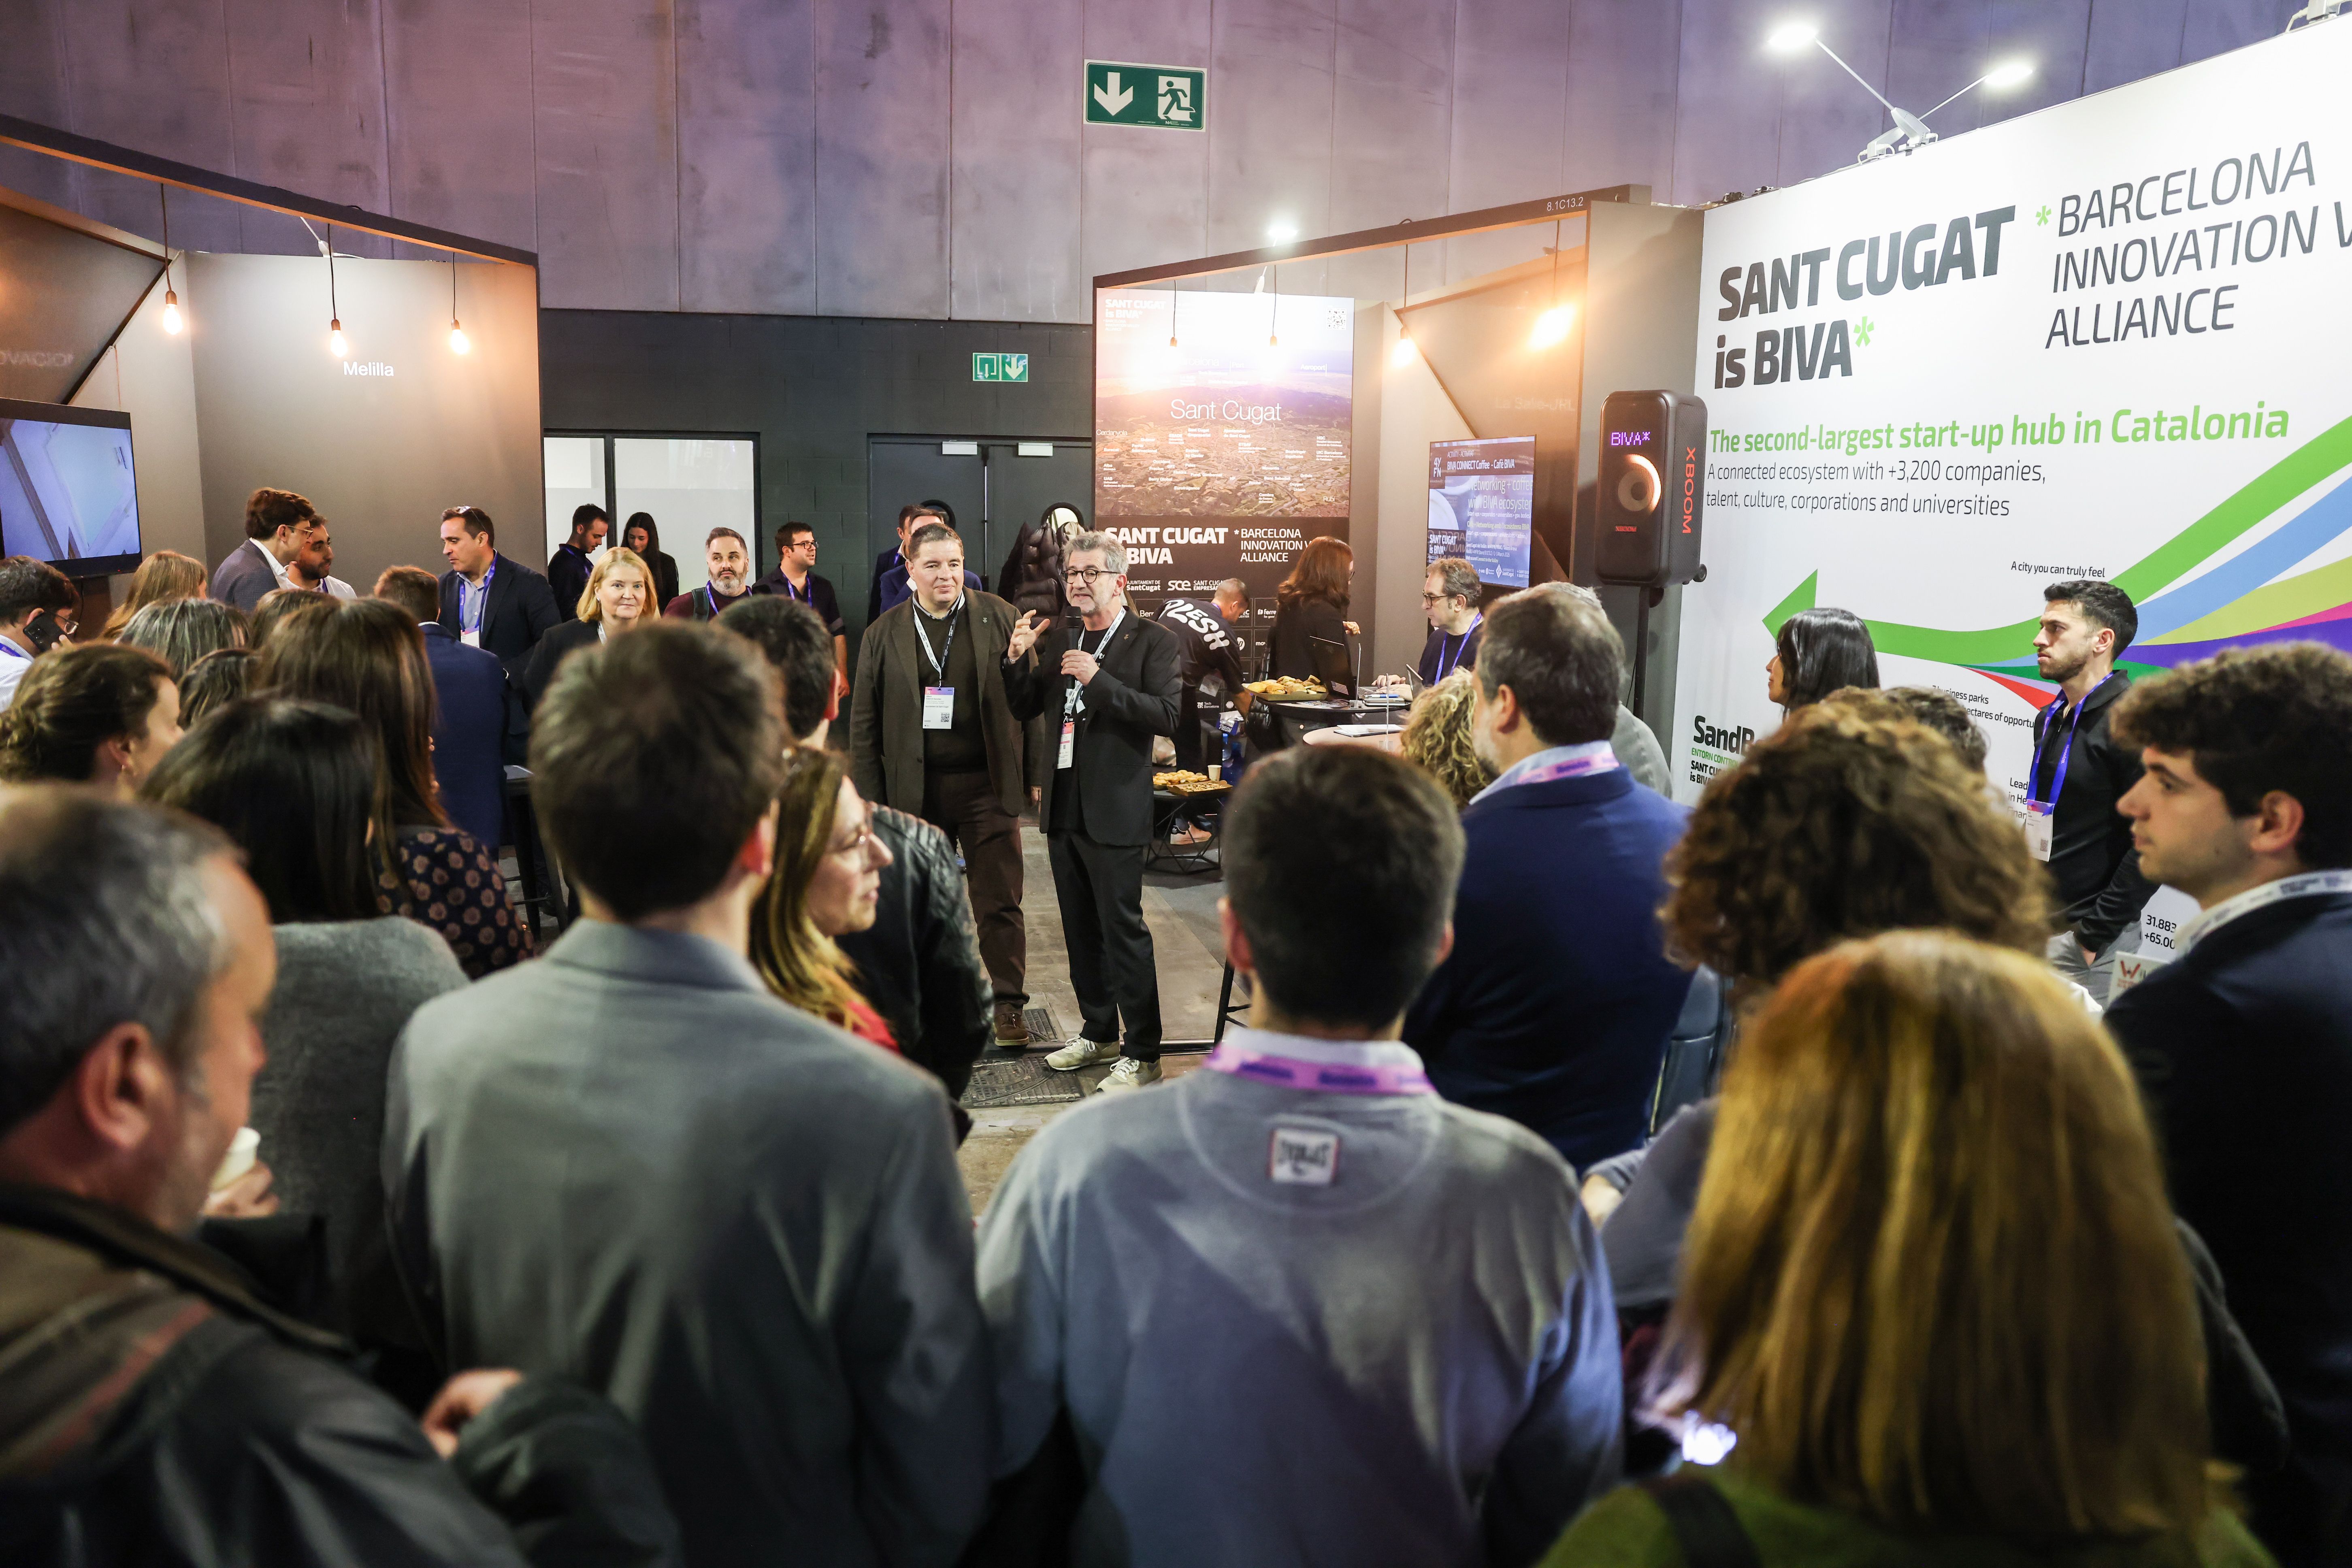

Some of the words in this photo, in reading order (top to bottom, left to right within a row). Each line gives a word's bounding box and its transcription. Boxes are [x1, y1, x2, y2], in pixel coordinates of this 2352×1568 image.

[1546, 197, 1584, 212] 8.1C13.2
[2053, 205, 2319, 293] INNOVATION
[1718, 248, 1830, 321] SANT
[1837, 205, 2015, 301] CUGAT
[1105, 299, 1132, 308] SANT
[1134, 300, 1166, 309] CUGAT
[1105, 309, 1114, 317] is
[2045, 284, 2239, 349] ALLIANCE
[1182, 356, 1219, 366] rcelona
[1715, 334, 1746, 389] is
[343, 361, 394, 377] Melilla
[1170, 399, 1216, 419] Sant
[1222, 401, 1282, 425] Cugat
[1711, 430, 1739, 453] The
[1743, 422, 1895, 456] second-largest
[1899, 416, 2004, 454] start-up
[2011, 413, 2065, 445] hub
[2074, 410, 2101, 443] in
[2110, 401, 2290, 443] Catalonia
[1434, 467, 1441, 477] FN
[1447, 462, 1456, 470] BIVA
[1457, 460, 1475, 470] CONNECT
[1476, 460, 1489, 469] Coffee
[1504, 459, 1515, 469] BIVA
[1708, 463, 1715, 480] A
[1717, 462, 1775, 481] connected
[1779, 462, 1849, 484] ecosystem
[1853, 460, 1883, 481] with
[1888, 460, 1941, 486] +3,200
[1945, 460, 2046, 486] companies,
[1682, 447, 1696, 533] XBOOM
[1483, 495, 1497, 509] BIVA
[1706, 490, 1741, 511] talent,
[1743, 490, 1787, 512] culture,
[1791, 491, 1876, 515] corporations
[1880, 492, 1908, 512] and
[1912, 493, 2010, 516] universities
[1105, 527, 1160, 544] SANT
[1163, 527, 1228, 544] CUGAT
[1430, 534, 1442, 543] SANT
[1442, 535, 1457, 545] CUGAT
[1241, 540, 1303, 550] INNOVATION
[1430, 545, 1433, 554] is
[1127, 548, 1173, 564] BIVA
[1240, 553, 1288, 562] ALLIANCE
[2011, 561, 2017, 570] A
[2018, 562, 2032, 574] city
[2034, 565, 2048, 575] you
[2050, 566, 2064, 574] can
[2067, 565, 2087, 578] truly
[2088, 567, 2105, 578] feel
[1167, 580, 1191, 591] sce
[1937, 686, 1967, 700] siness
[1969, 695, 1989, 704] parks
[1964, 706, 1993, 720] ectares
[1995, 713, 2003, 721] of
[1692, 748, 1713, 761] ENTORN
[1691, 760, 1708, 773] SANT
[1690, 771, 1696, 782] is
[2010, 778, 2028, 790] Lead
[2009, 792, 2015, 801] in
[2146, 915, 2177, 933] 31.883
